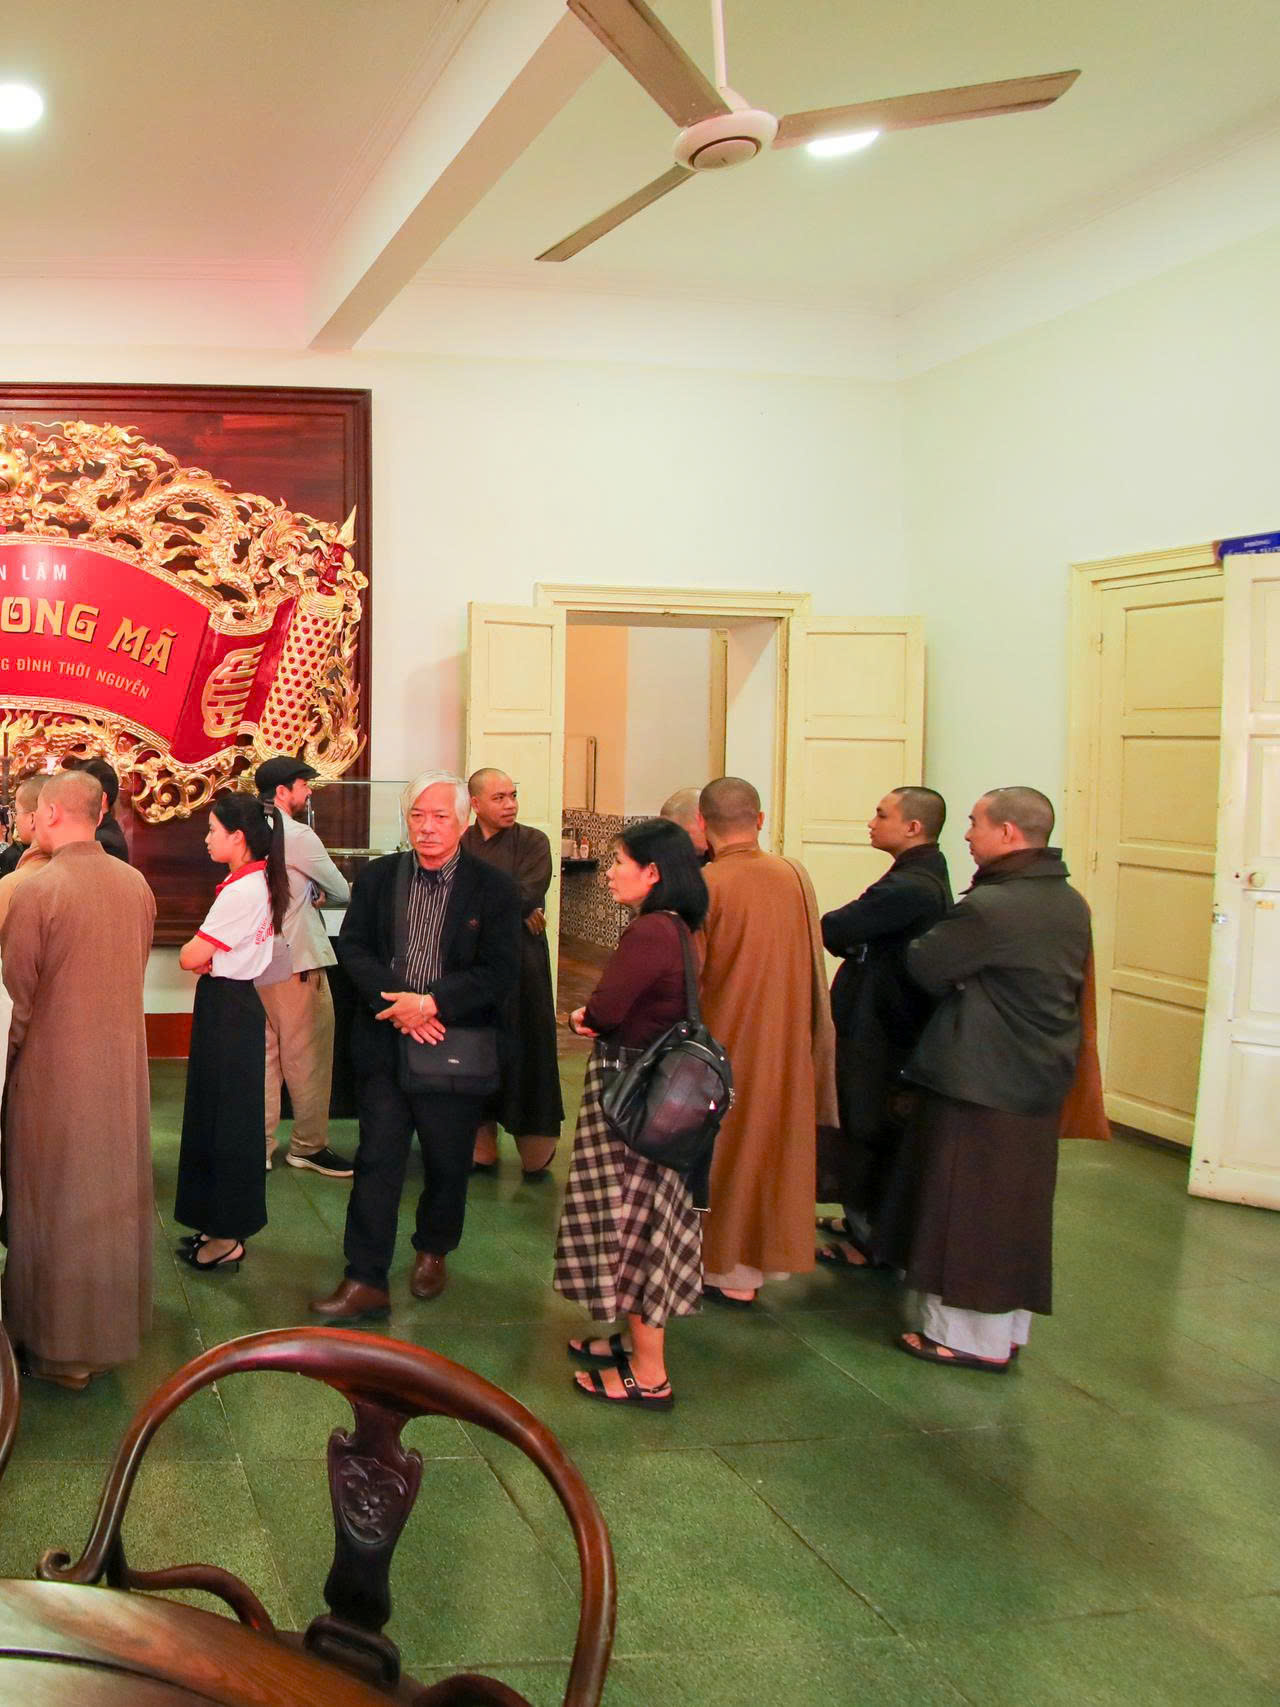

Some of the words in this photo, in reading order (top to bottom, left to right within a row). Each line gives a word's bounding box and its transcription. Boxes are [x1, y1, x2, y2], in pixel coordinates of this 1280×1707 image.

[22, 561, 67, 581] LÃM
[107, 616, 178, 675] MÃ
[16, 656, 52, 673] ĐÌNH
[58, 661, 91, 679] THỜI
[96, 669, 151, 699] NGUYỄN
